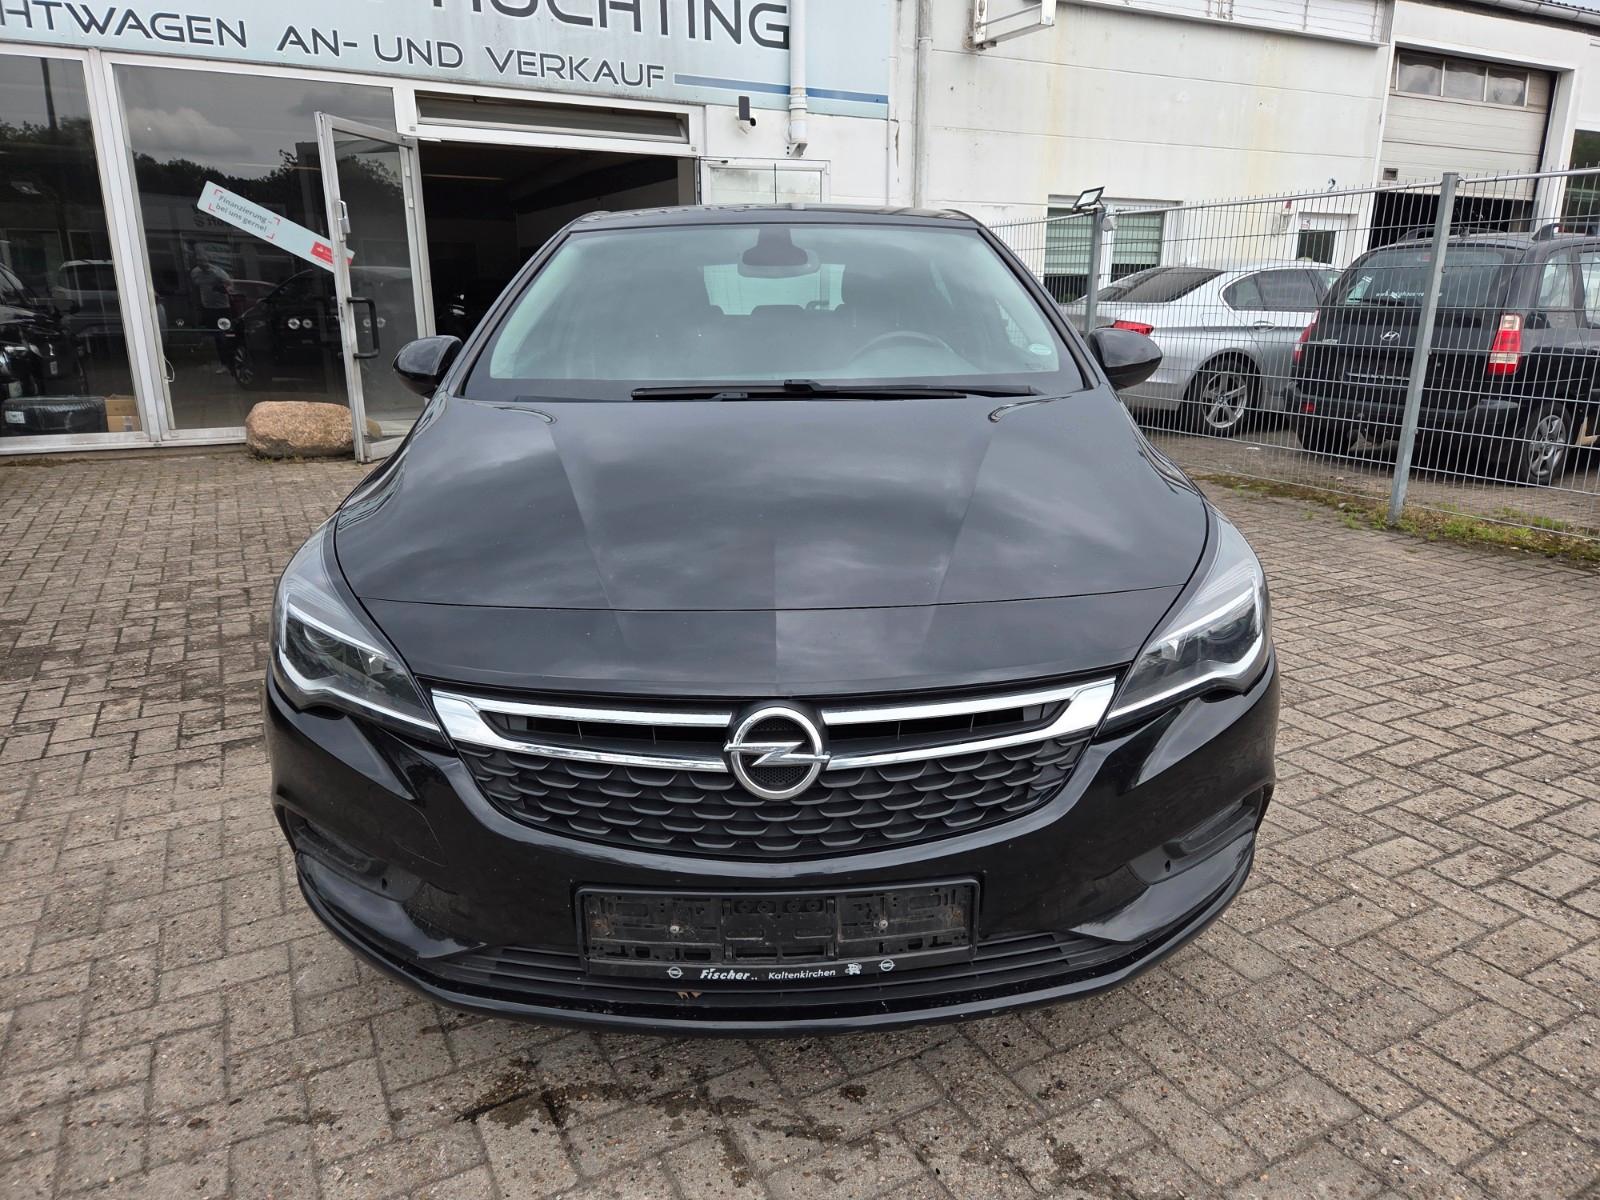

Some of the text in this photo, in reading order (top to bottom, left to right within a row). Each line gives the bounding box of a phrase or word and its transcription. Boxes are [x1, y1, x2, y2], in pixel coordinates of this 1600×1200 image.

[277, 25, 358, 57] AN-
[373, 34, 463, 68] UND
[485, 46, 664, 88] VERKAUF
[216, 203, 228, 214] bei
[228, 209, 242, 221] uns
[768, 969, 836, 981] Kaltenkirchen
